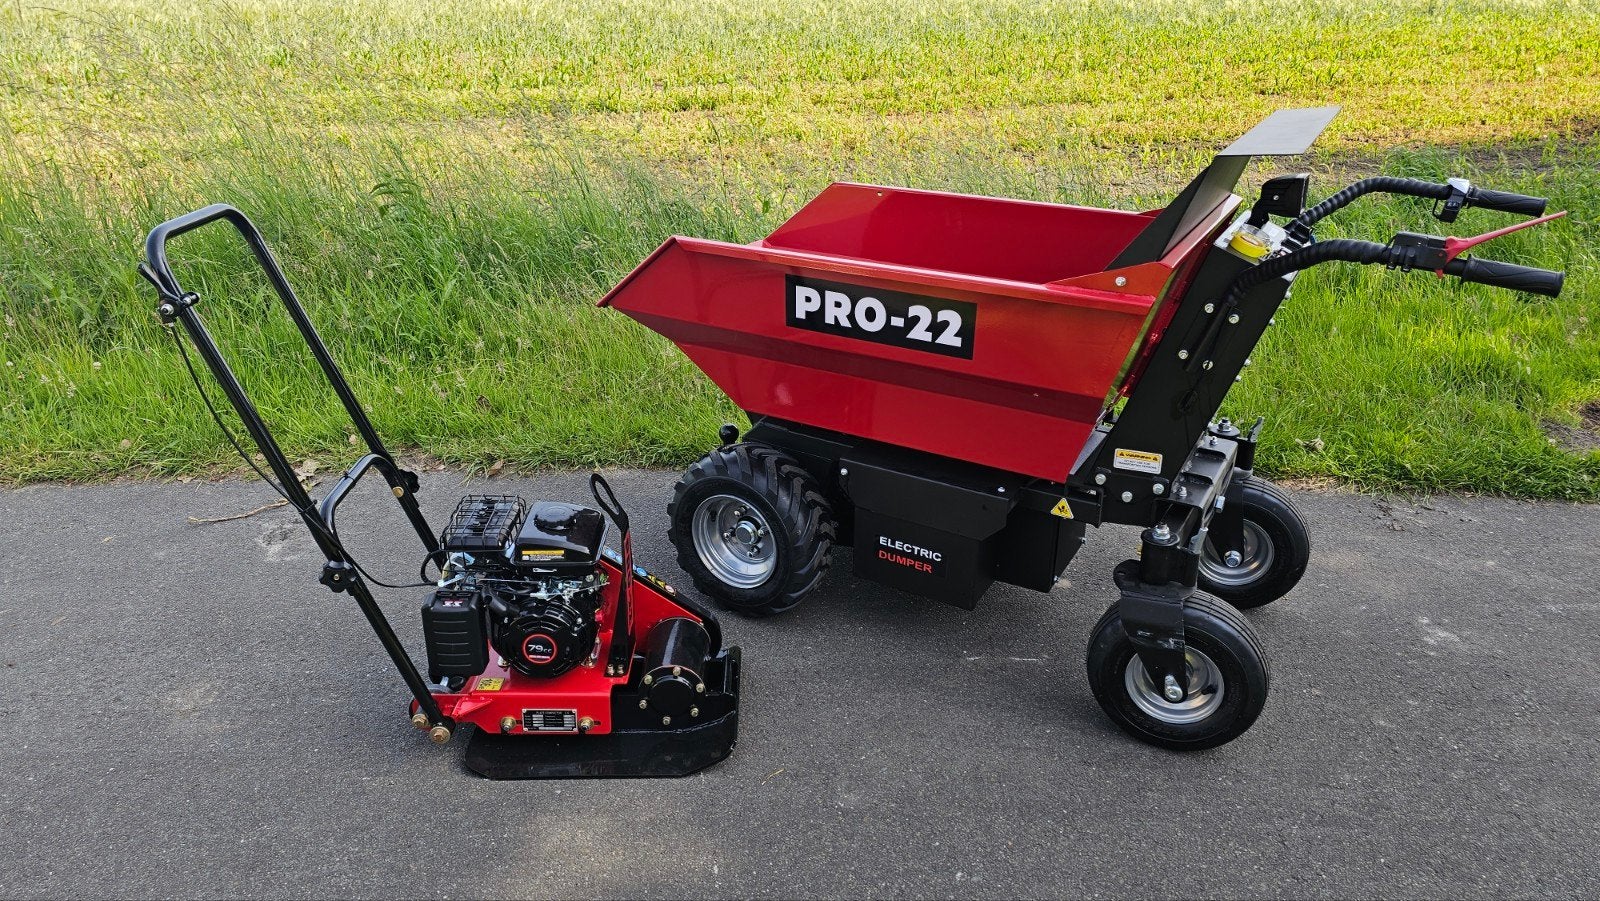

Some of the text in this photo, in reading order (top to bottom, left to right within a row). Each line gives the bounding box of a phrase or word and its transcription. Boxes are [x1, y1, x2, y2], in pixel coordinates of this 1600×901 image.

[795, 285, 962, 347] PRO-22
[878, 550, 932, 574] DUMPER
[879, 536, 942, 562] ELECTRIC
